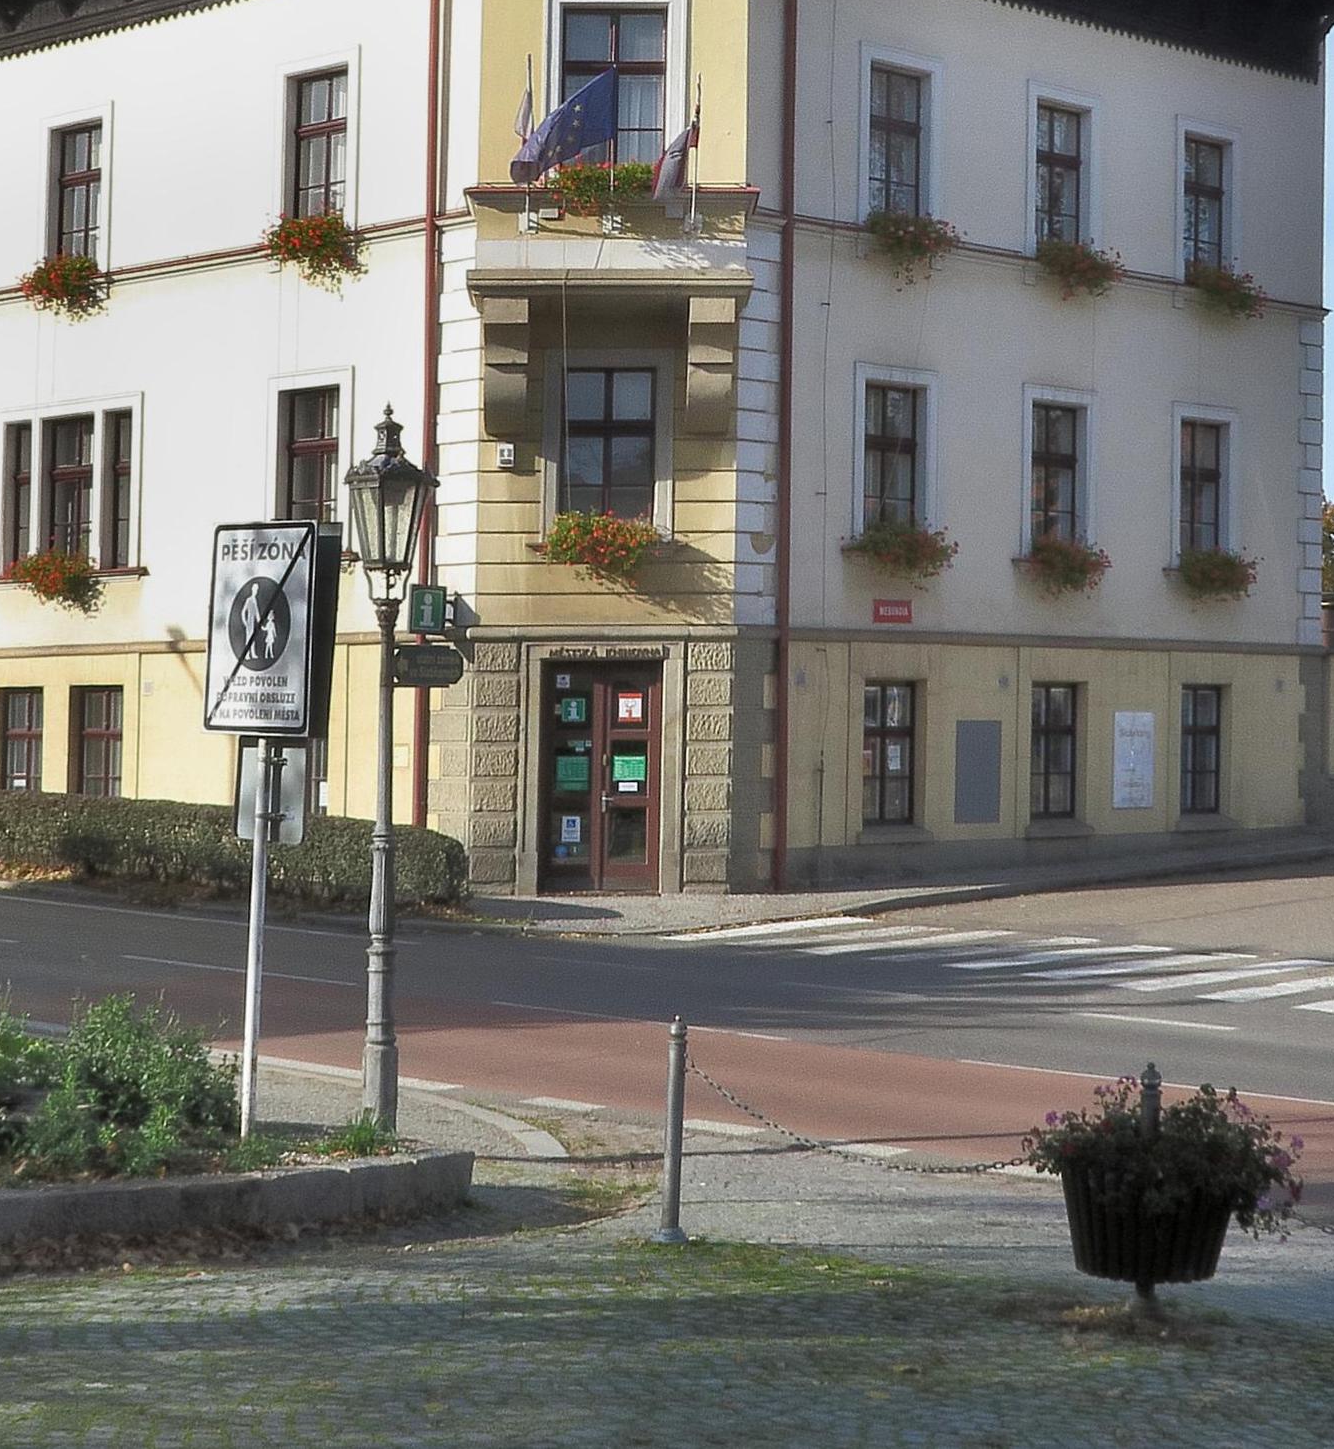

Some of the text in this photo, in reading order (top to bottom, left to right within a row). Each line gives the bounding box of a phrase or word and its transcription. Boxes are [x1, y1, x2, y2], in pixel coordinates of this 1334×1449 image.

[222, 537, 306, 561] PĚŠÍ ZÓNA
[249, 675, 288, 688] POVOLEN
